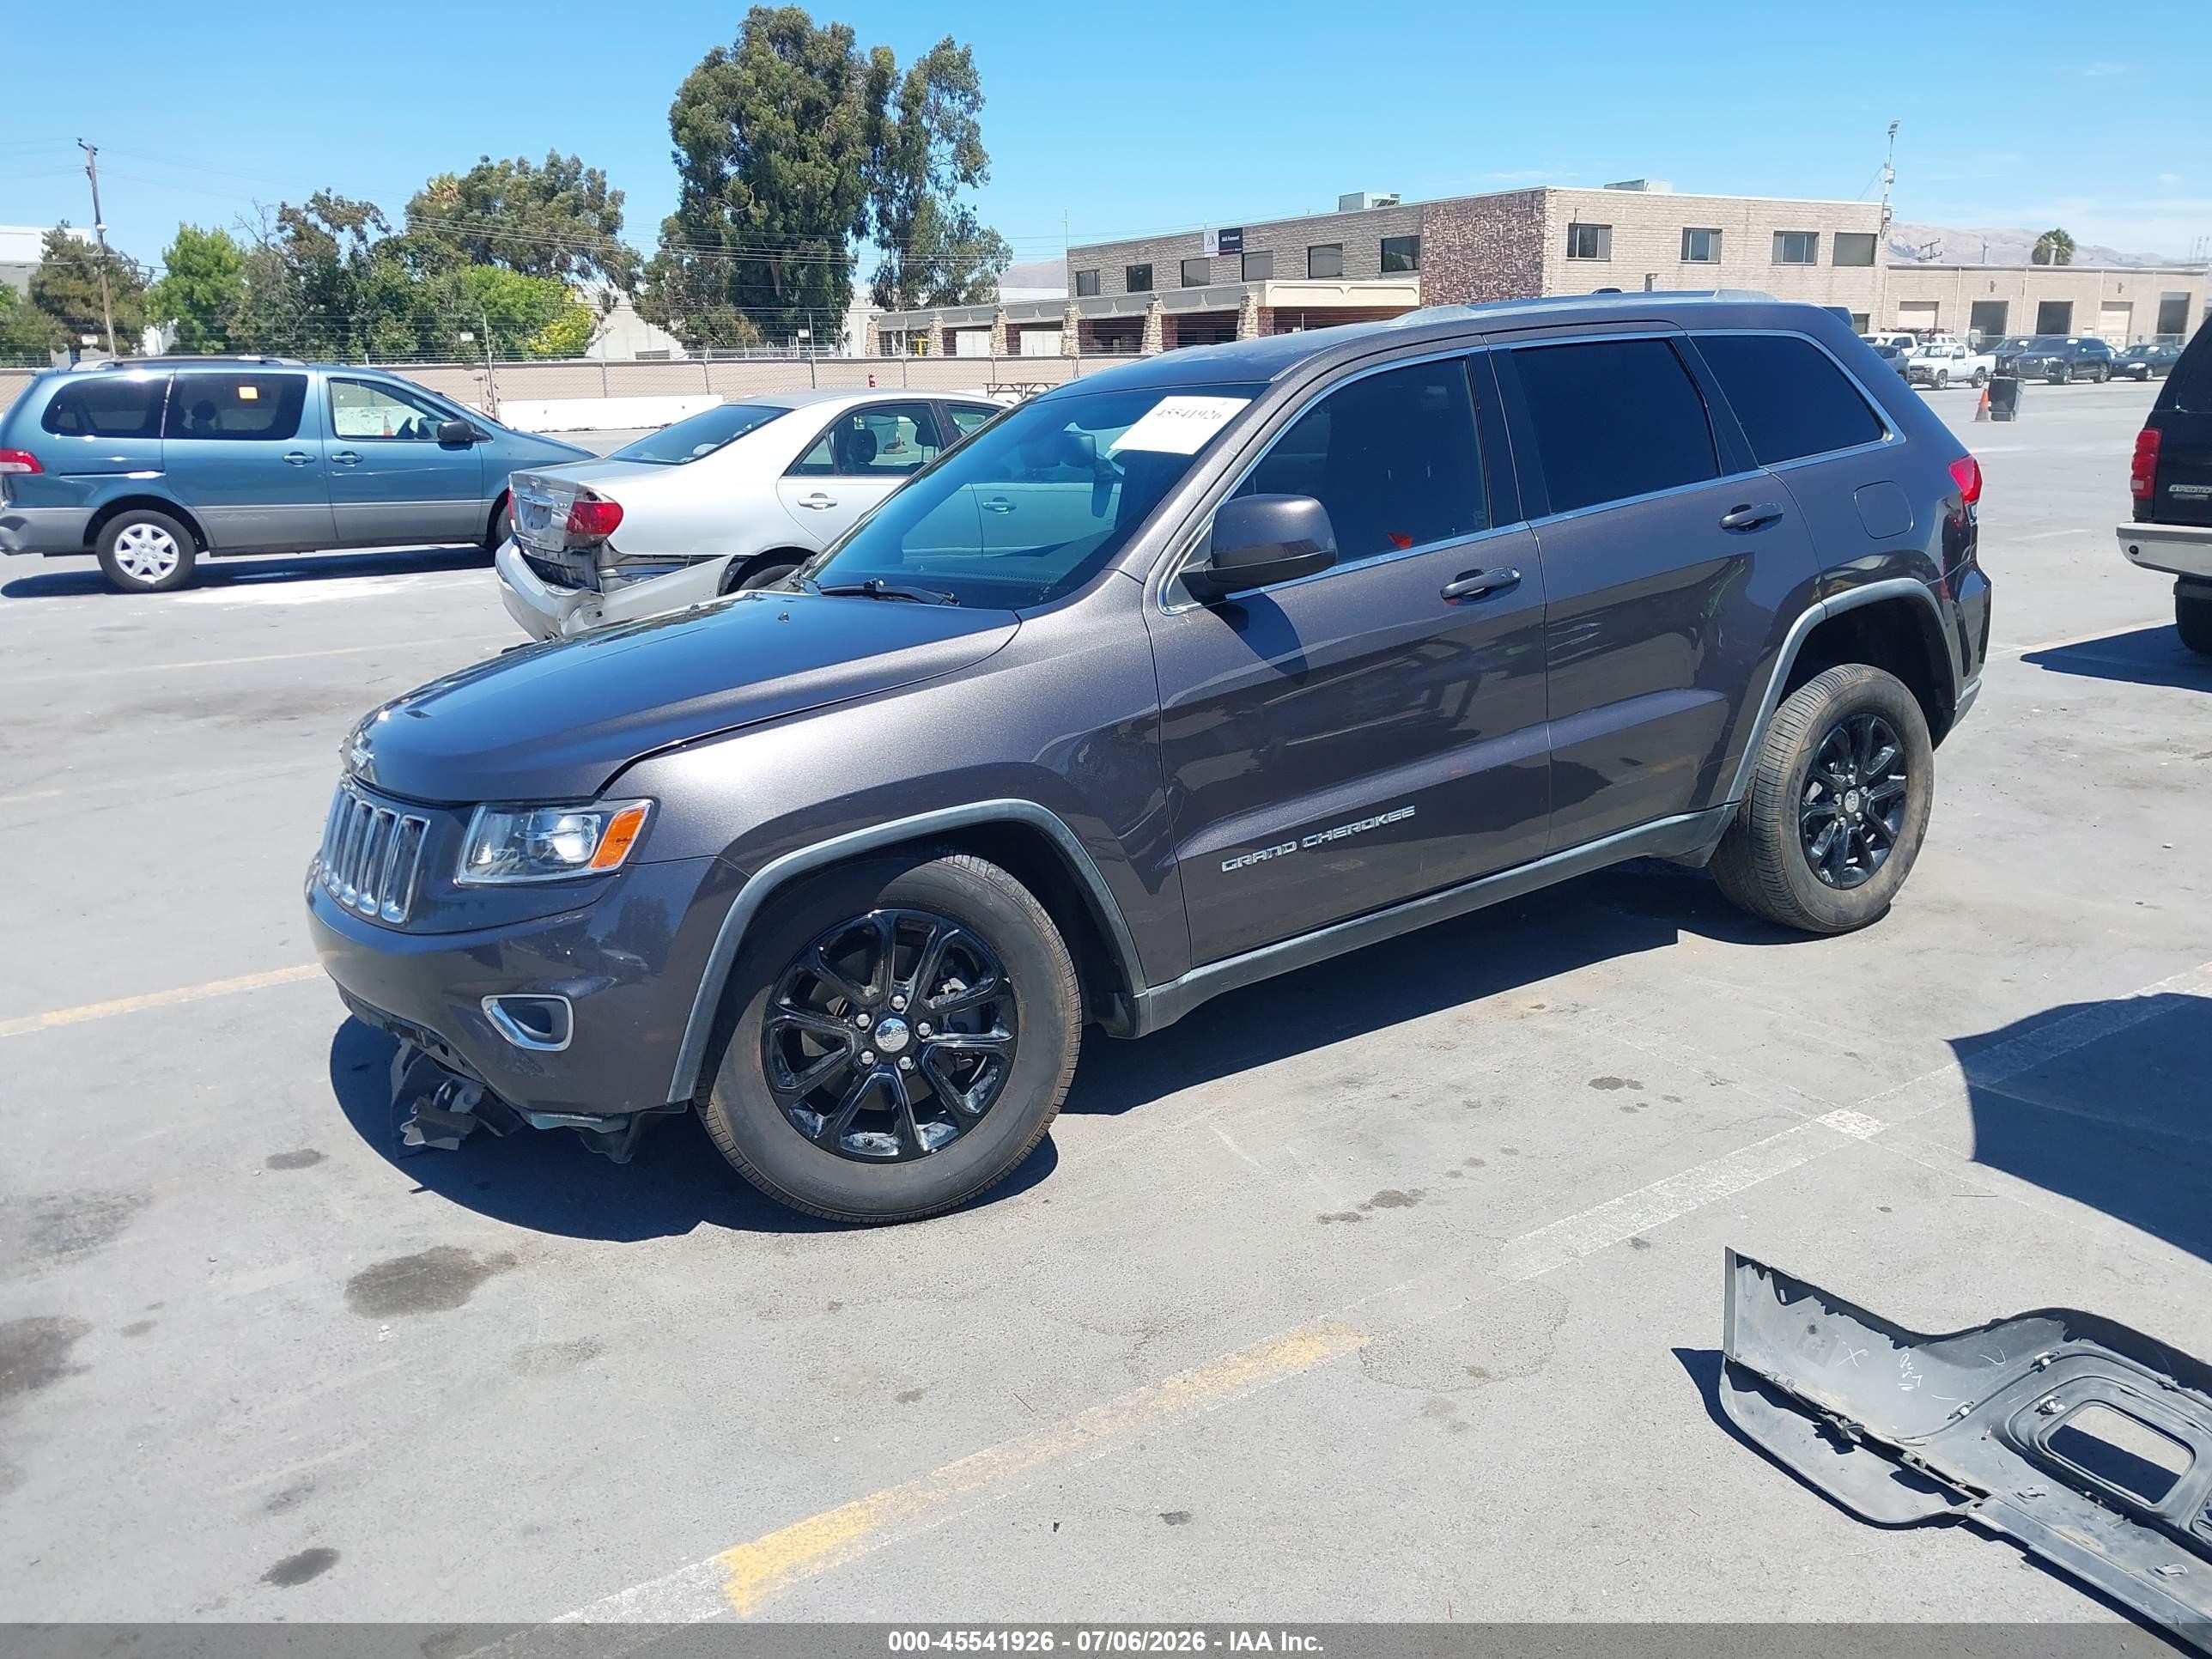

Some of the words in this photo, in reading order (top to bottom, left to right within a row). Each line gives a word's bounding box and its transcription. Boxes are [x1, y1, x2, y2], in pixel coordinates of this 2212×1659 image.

[2168, 484, 2212, 494] EXPEDITIO
[1221, 841, 1297, 872] GRAND
[1302, 805, 1416, 848] CHEROKEE
